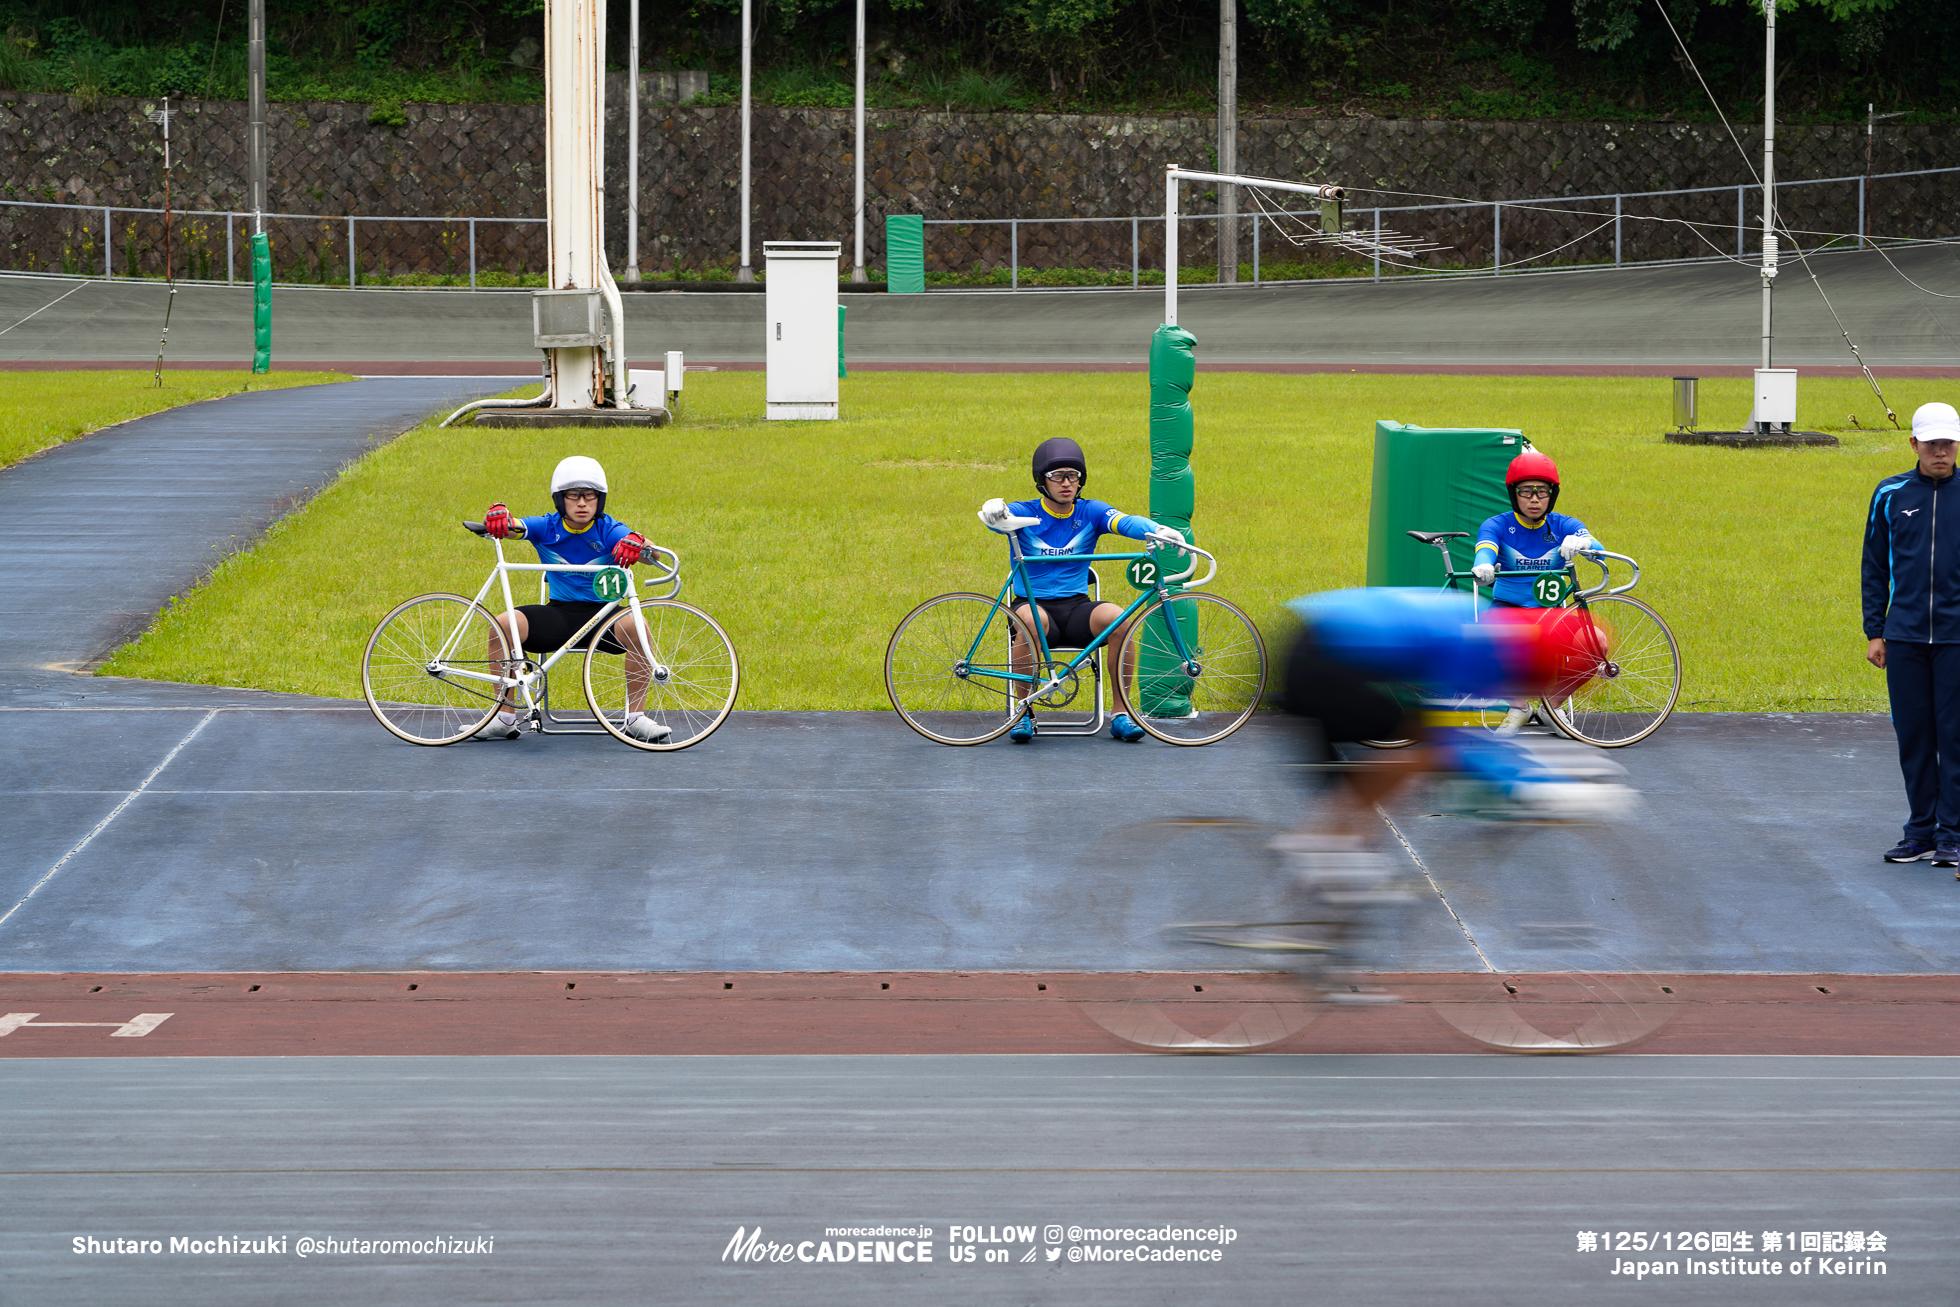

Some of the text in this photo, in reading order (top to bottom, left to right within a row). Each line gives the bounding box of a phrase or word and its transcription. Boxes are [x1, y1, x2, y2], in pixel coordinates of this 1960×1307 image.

[1041, 547, 1074, 556] KEIRIN
[1131, 563, 1156, 584] 12
[599, 574, 620, 596] 11
[1536, 579, 1561, 602] 13
